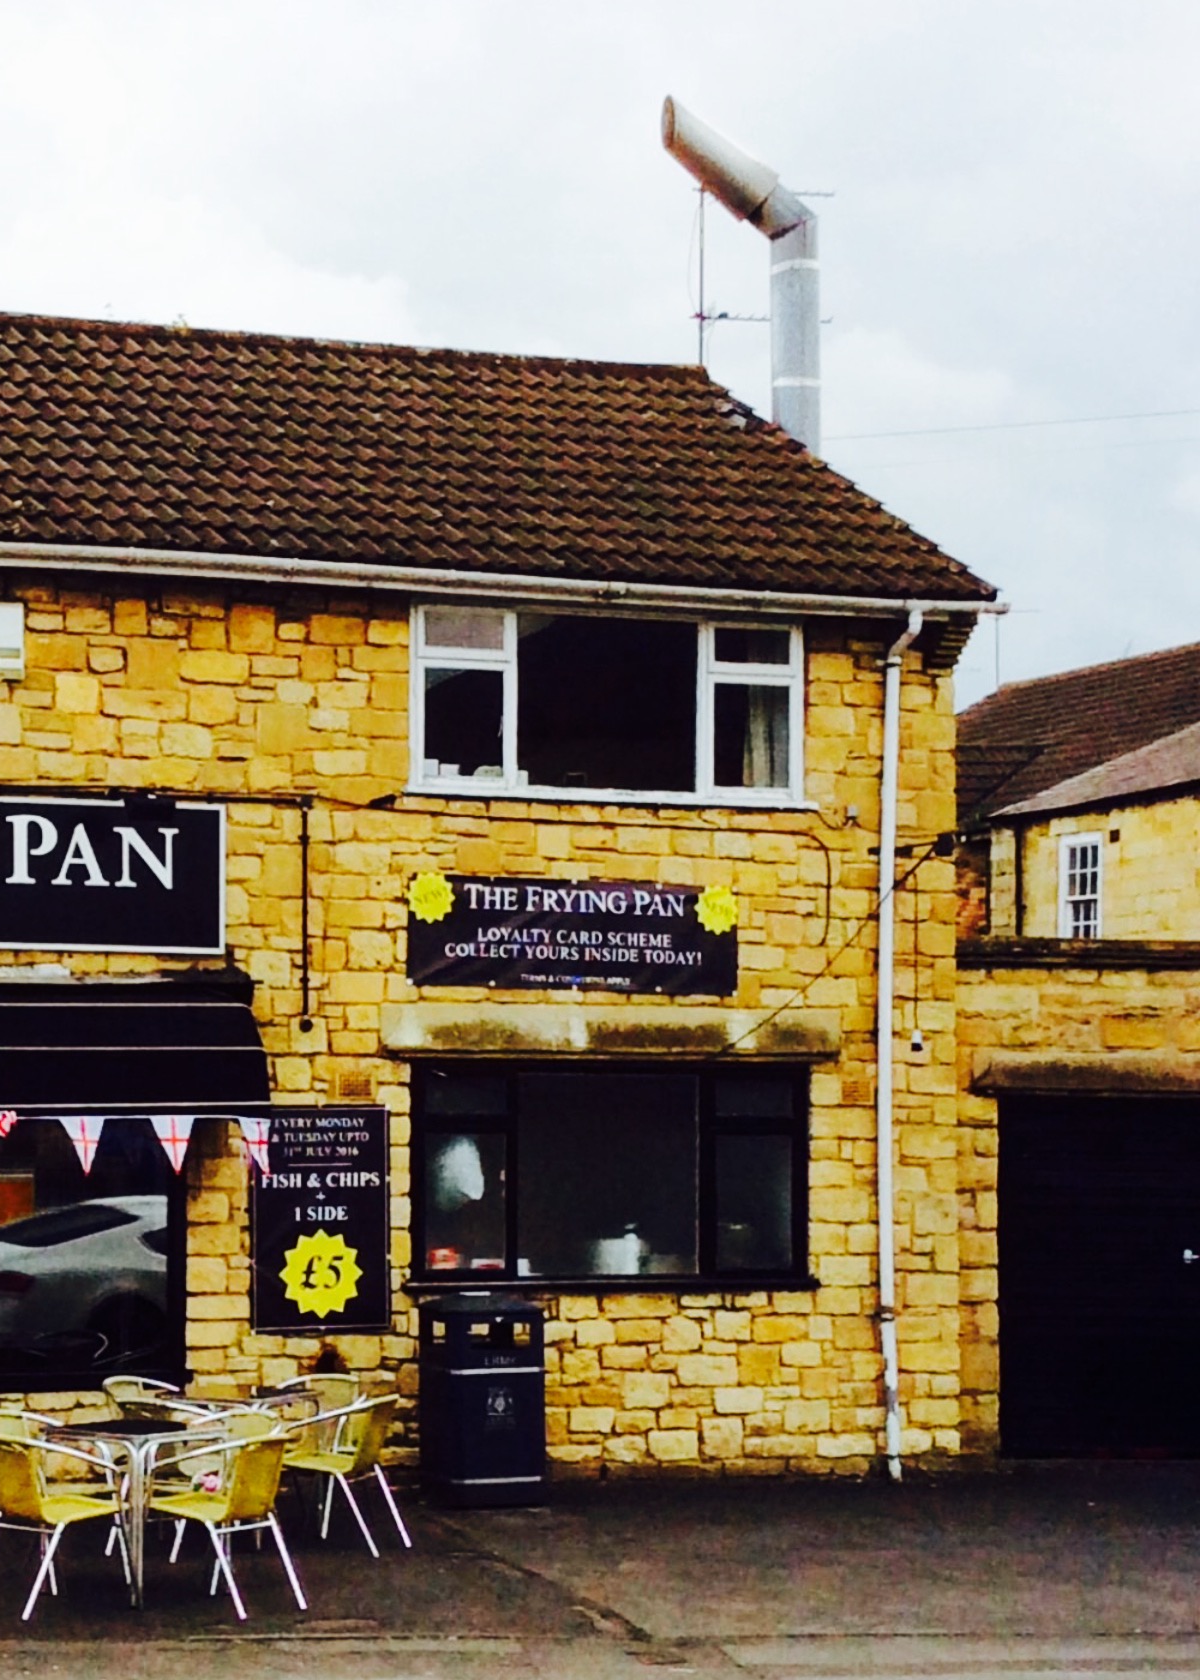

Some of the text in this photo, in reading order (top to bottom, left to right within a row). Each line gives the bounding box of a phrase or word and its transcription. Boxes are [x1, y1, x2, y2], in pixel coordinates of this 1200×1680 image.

[5, 814, 180, 890] PAN
[463, 883, 686, 917] THE FRYING PAN
[477, 927, 673, 948] LOYALTY CARD SCHEME
[444, 942, 702, 966] COLLECT YOURS INSIDE TODAY!
[274, 1117, 366, 1129] EVERY MONDAY
[284, 1131, 337, 1142] TUESDAY
[305, 1146, 332, 1157] JULY
[261, 1171, 381, 1189] FISH & CHIPS
[307, 1205, 349, 1221] SIDE
[300, 1254, 344, 1291] £5
